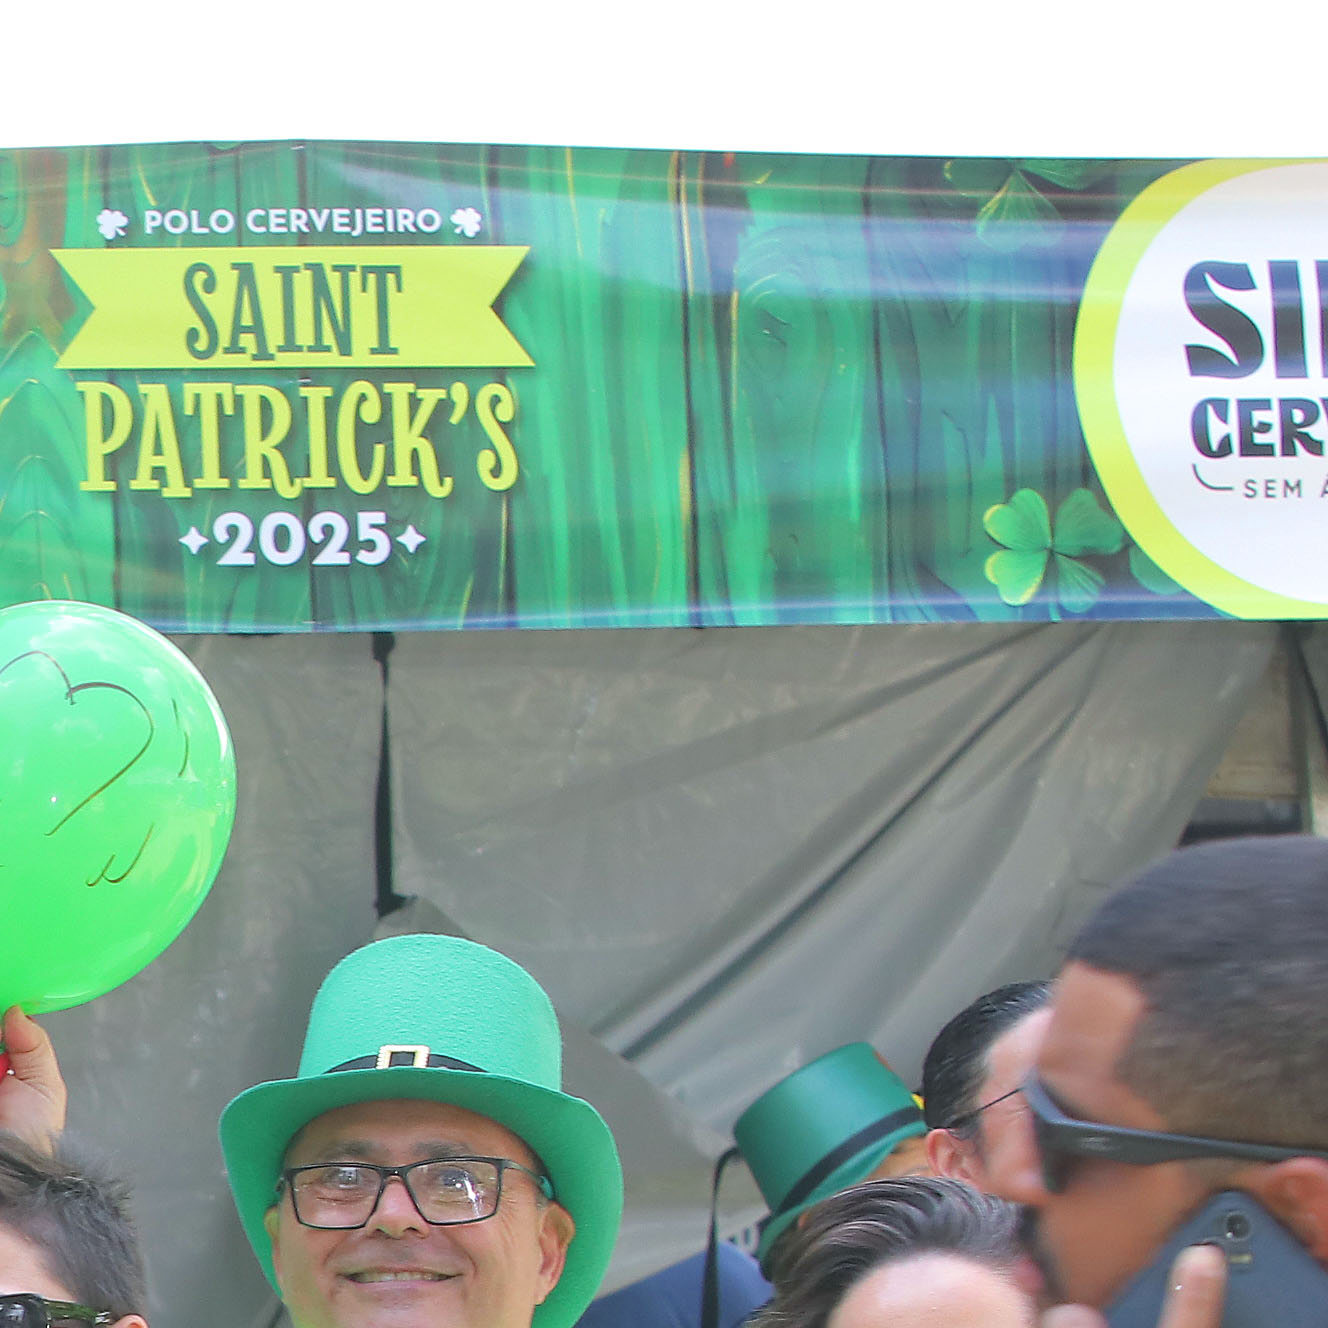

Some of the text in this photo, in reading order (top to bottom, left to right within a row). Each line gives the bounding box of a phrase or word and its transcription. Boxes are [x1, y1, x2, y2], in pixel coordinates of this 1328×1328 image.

[145, 208, 443, 236] POLO CERVEJEIRO
[183, 262, 403, 361] SAINT
[1182, 260, 1328, 379] SI
[75, 380, 519, 499] PATRICK'S
[1190, 397, 1328, 459] CER
[1243, 479, 1303, 499] SEM
[212, 511, 392, 567] 2025
